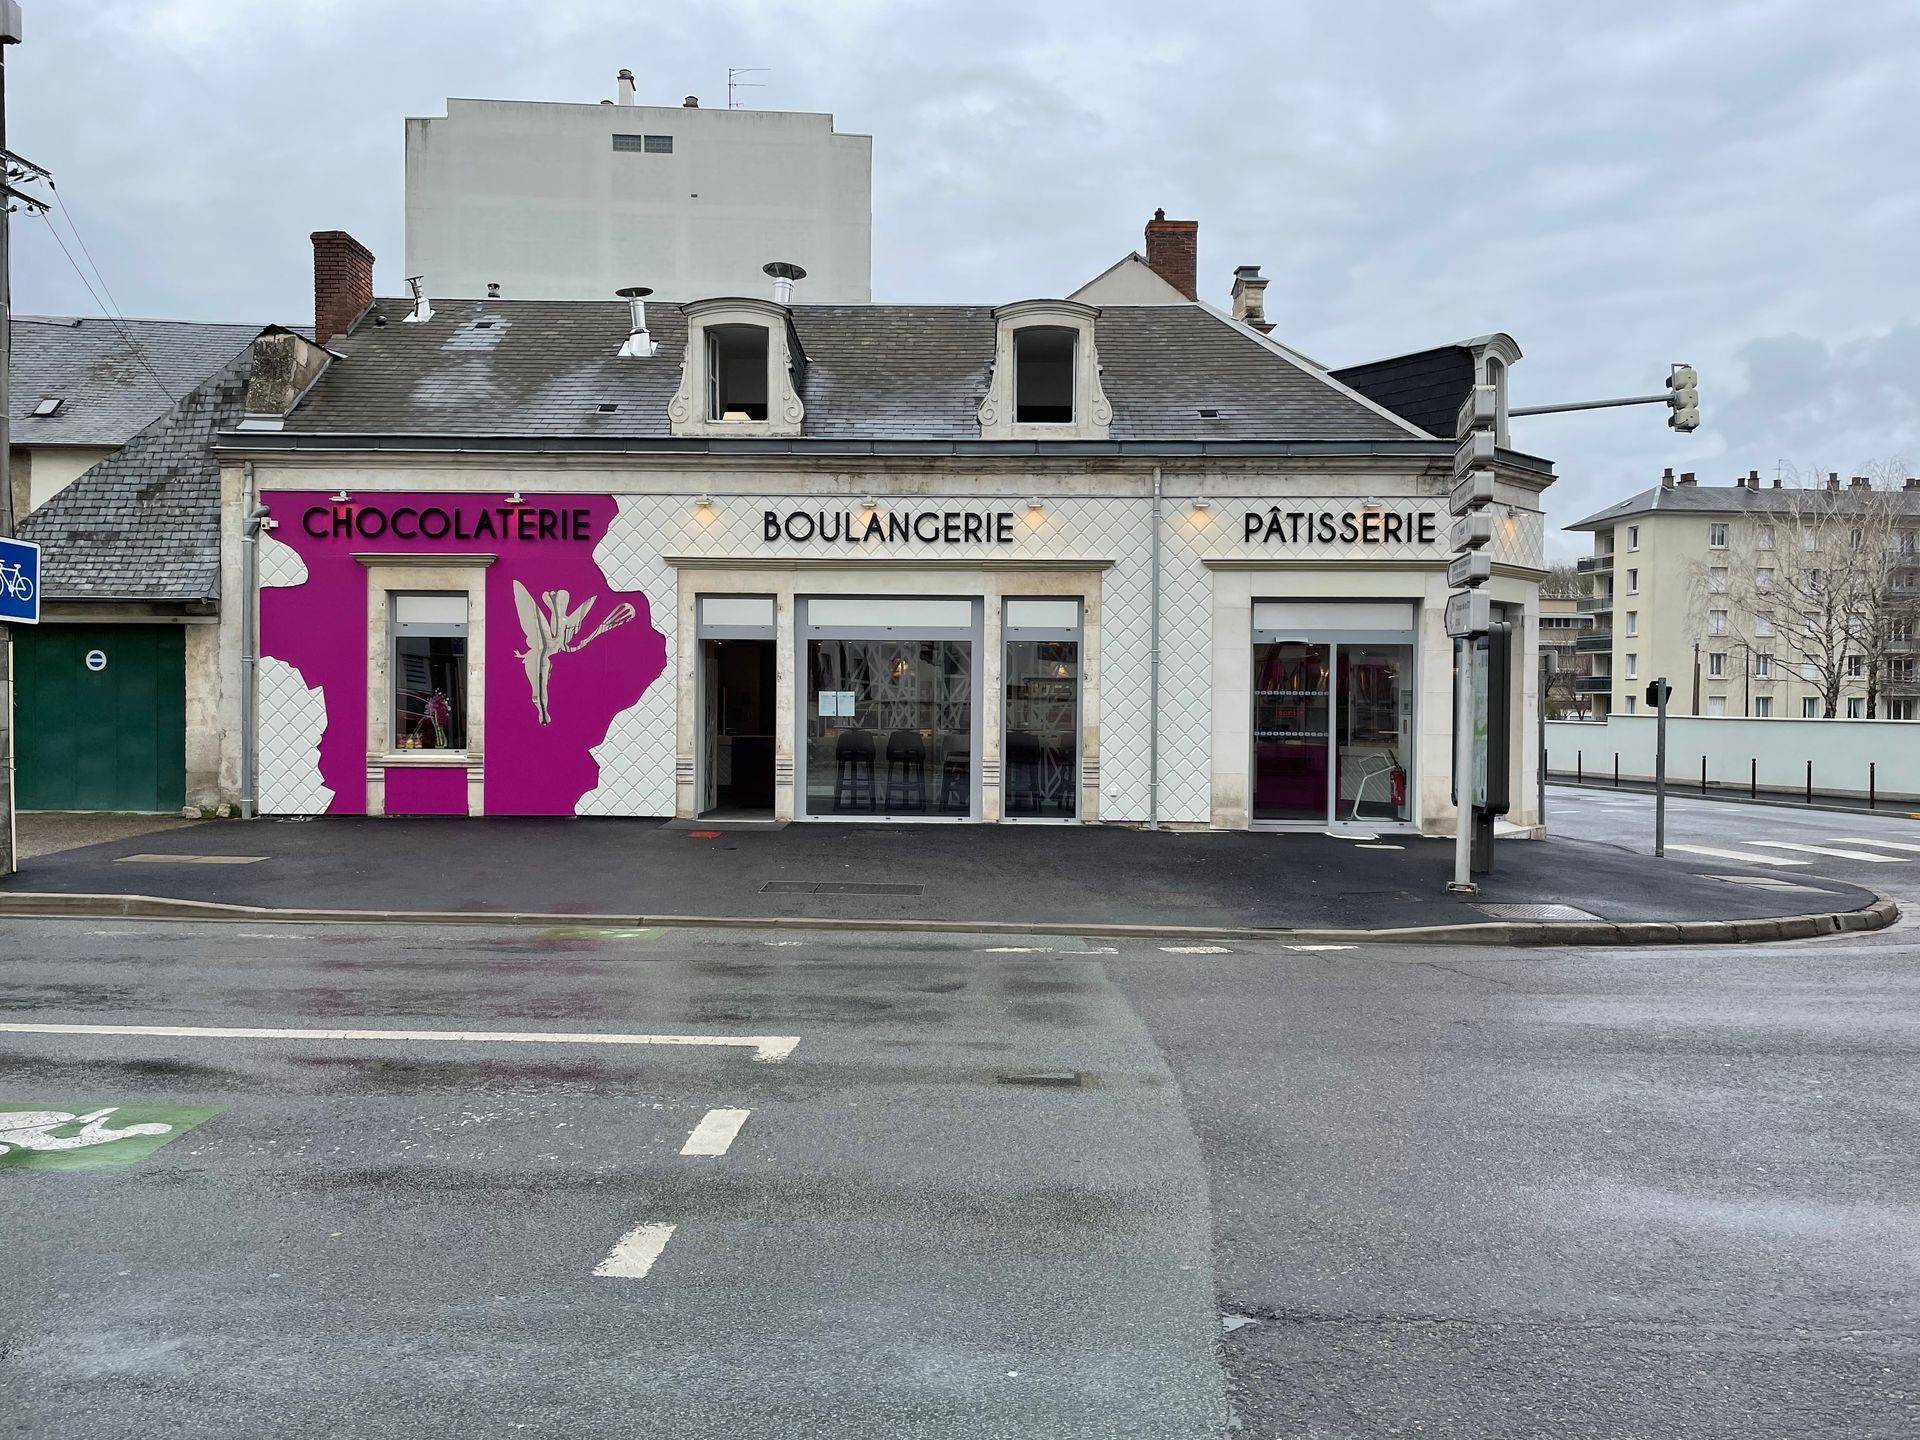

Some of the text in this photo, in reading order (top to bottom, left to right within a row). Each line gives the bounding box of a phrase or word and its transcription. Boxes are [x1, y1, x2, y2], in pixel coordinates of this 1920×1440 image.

[302, 507, 590, 540] CHOCOLATERIE
[764, 511, 1014, 543] BOULANGERIE
[1244, 505, 1436, 544] PÂTISSERIE
